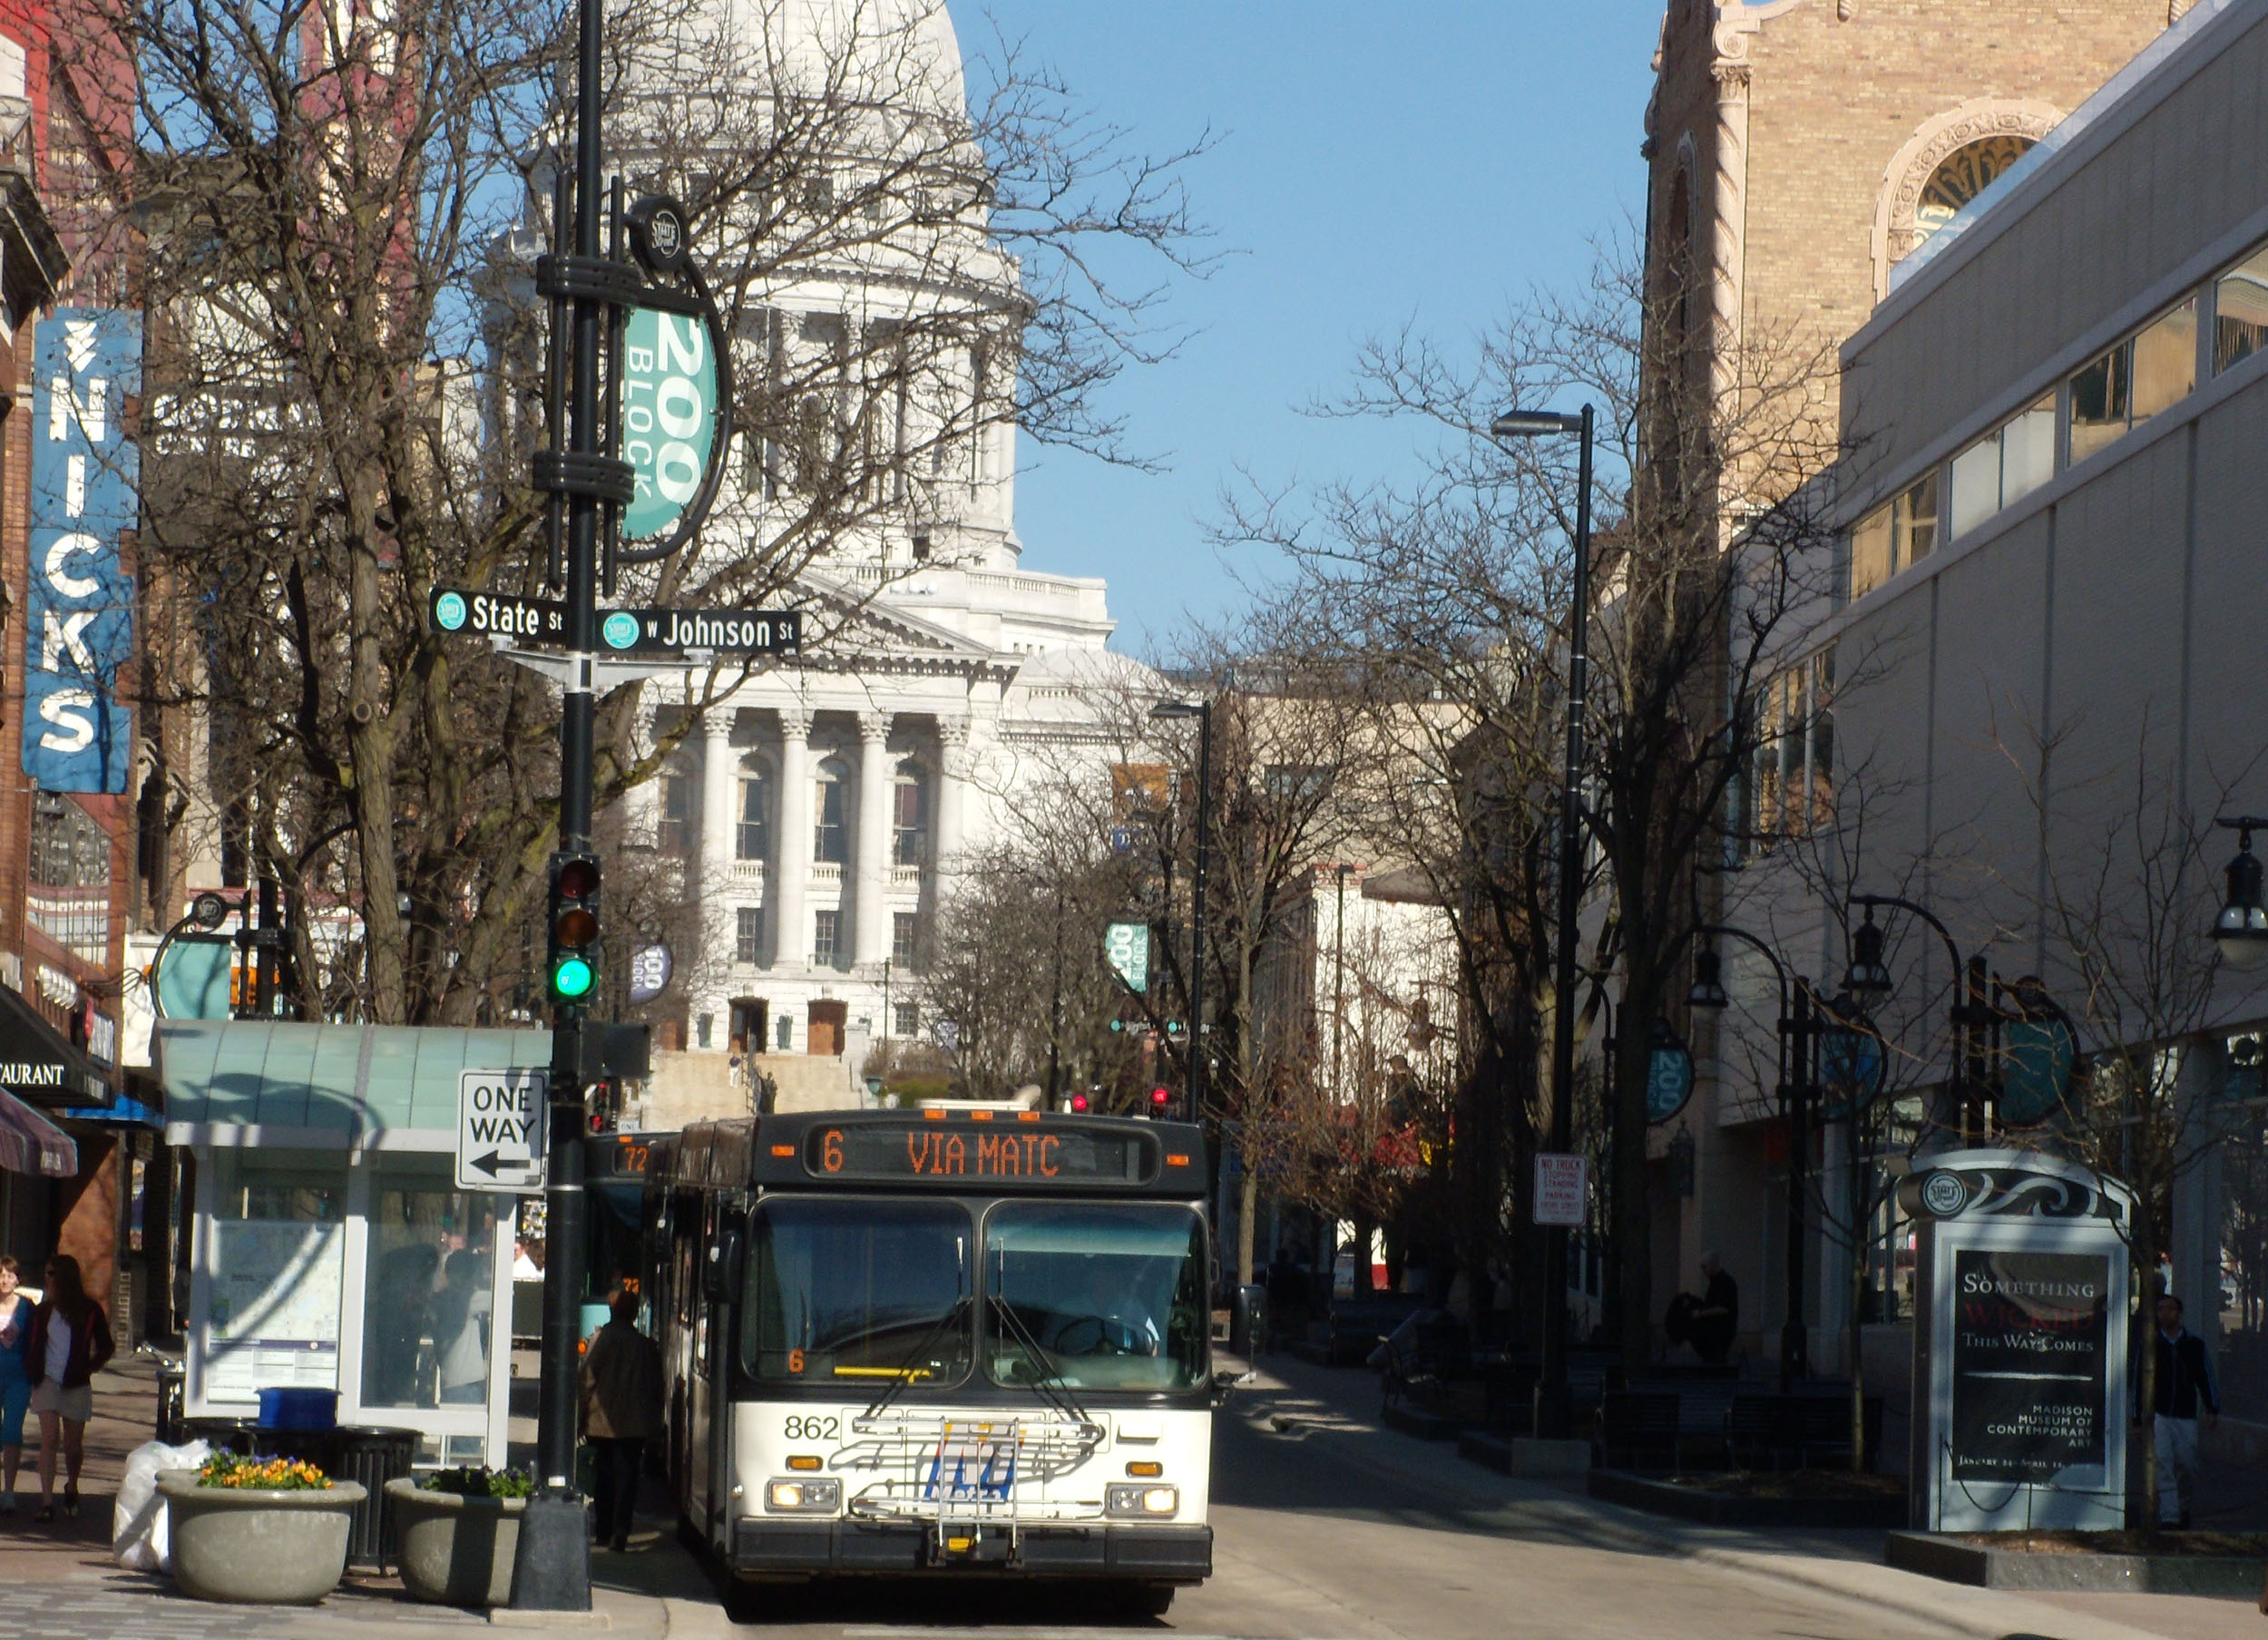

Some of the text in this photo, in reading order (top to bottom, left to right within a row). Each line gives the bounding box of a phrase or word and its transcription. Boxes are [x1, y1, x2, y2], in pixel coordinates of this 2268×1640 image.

[656, 311, 705, 505] 200
[626, 345, 654, 499] BLOCK
[40, 376, 107, 754] NICKS
[472, 595, 563, 636] State St
[647, 613, 794, 648] W Johnson St
[1657, 1051, 1685, 1110] 200
[473, 1086, 533, 1112] ONE
[470, 1117, 536, 1144] WAY
[624, 1146, 650, 1172] 72
[823, 1130, 1060, 1176] 6 VIA MATC
[1541, 1158, 1581, 1170] NO TRUCK
[1963, 1272, 2095, 1298] SOMETHING
[1962, 1332, 1999, 1349] THIS
[788, 1349, 804, 1372] 6
[2019, 1415, 2093, 1426] MUSEUM OF
[2033, 1405, 2093, 1416] MADISON
[784, 1416, 839, 1440] 862
[1987, 1425, 2093, 1437] CONTEMPORARY
[2068, 1438, 2093, 1448] ART
